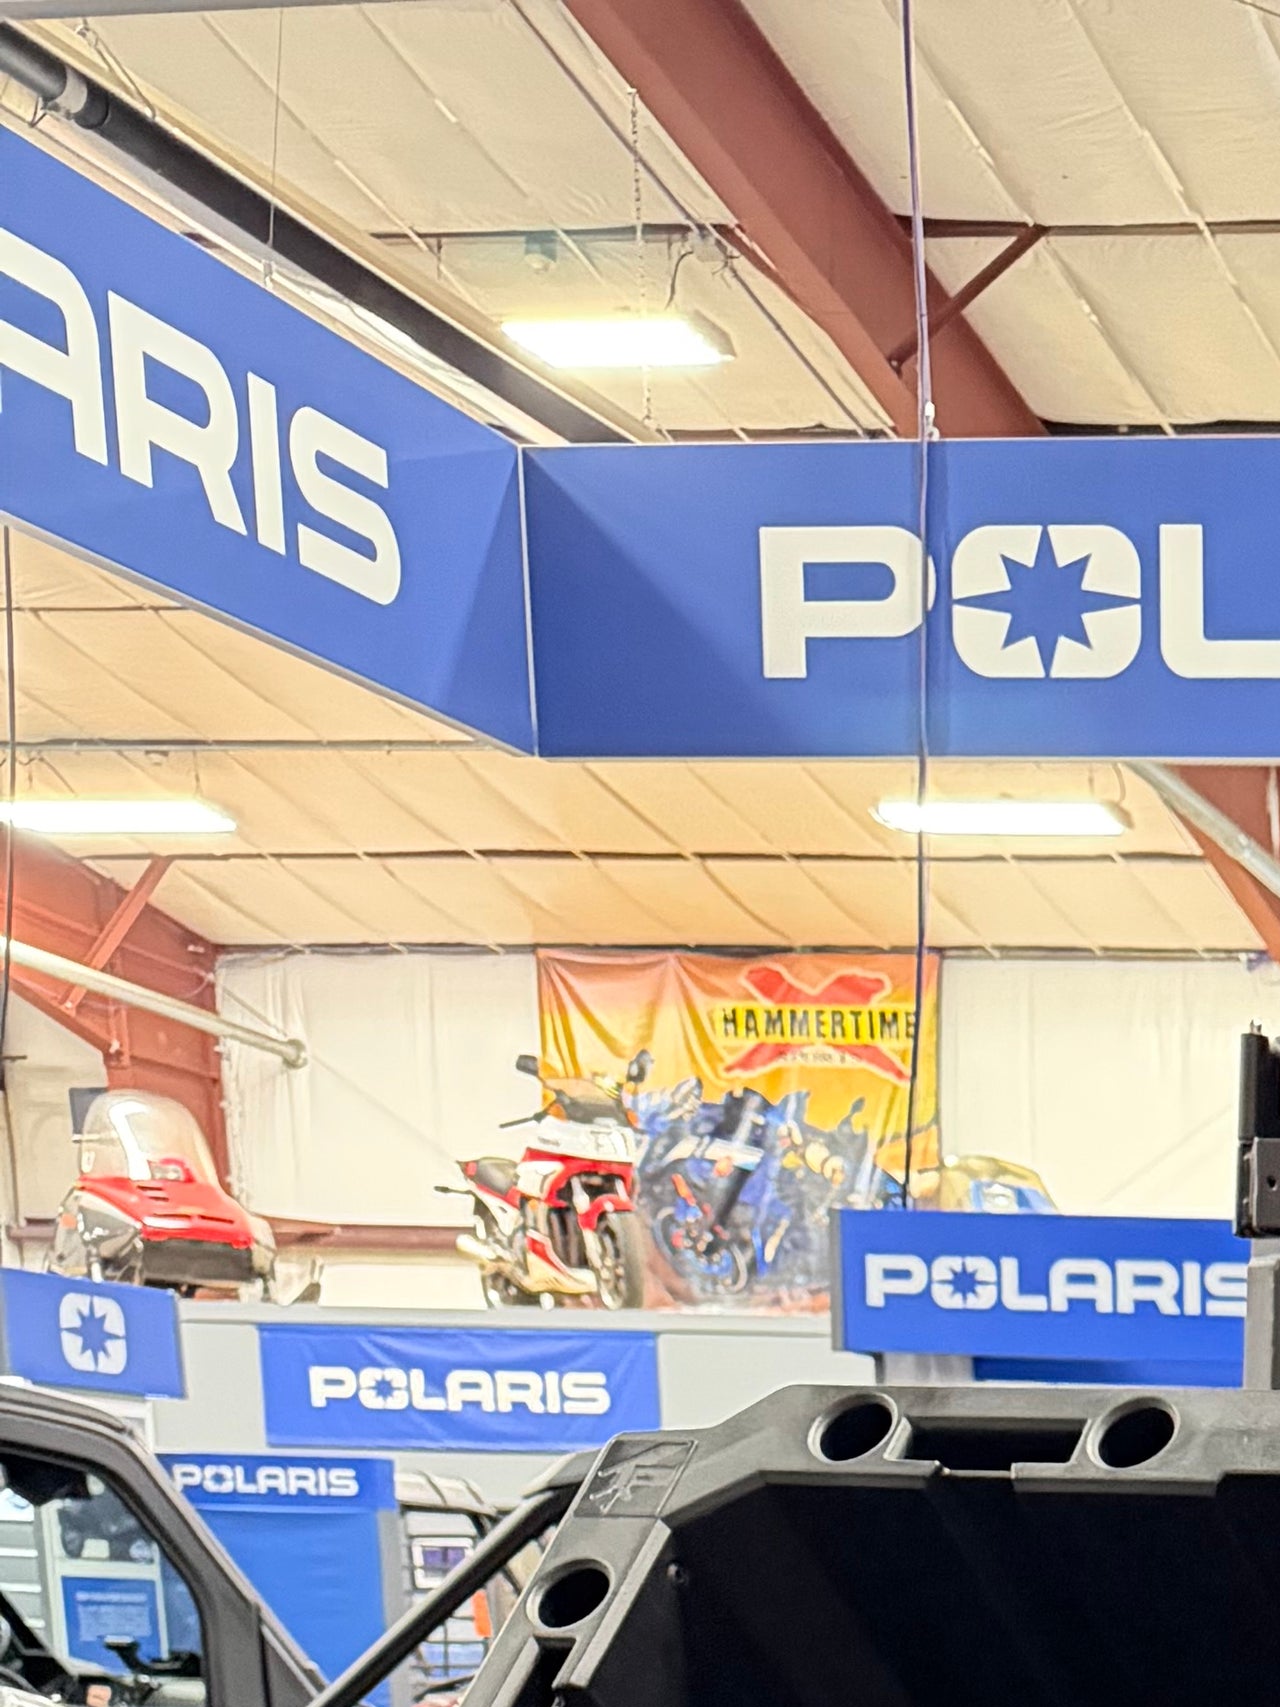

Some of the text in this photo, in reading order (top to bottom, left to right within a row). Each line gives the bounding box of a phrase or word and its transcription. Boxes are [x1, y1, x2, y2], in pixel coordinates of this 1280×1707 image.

[722, 1007, 914, 1040] HAMMERTIME
[864, 1253, 1247, 1318] POLARIS
[308, 1365, 611, 1415] POLARIS
[172, 1463, 359, 1497] POLARIS
